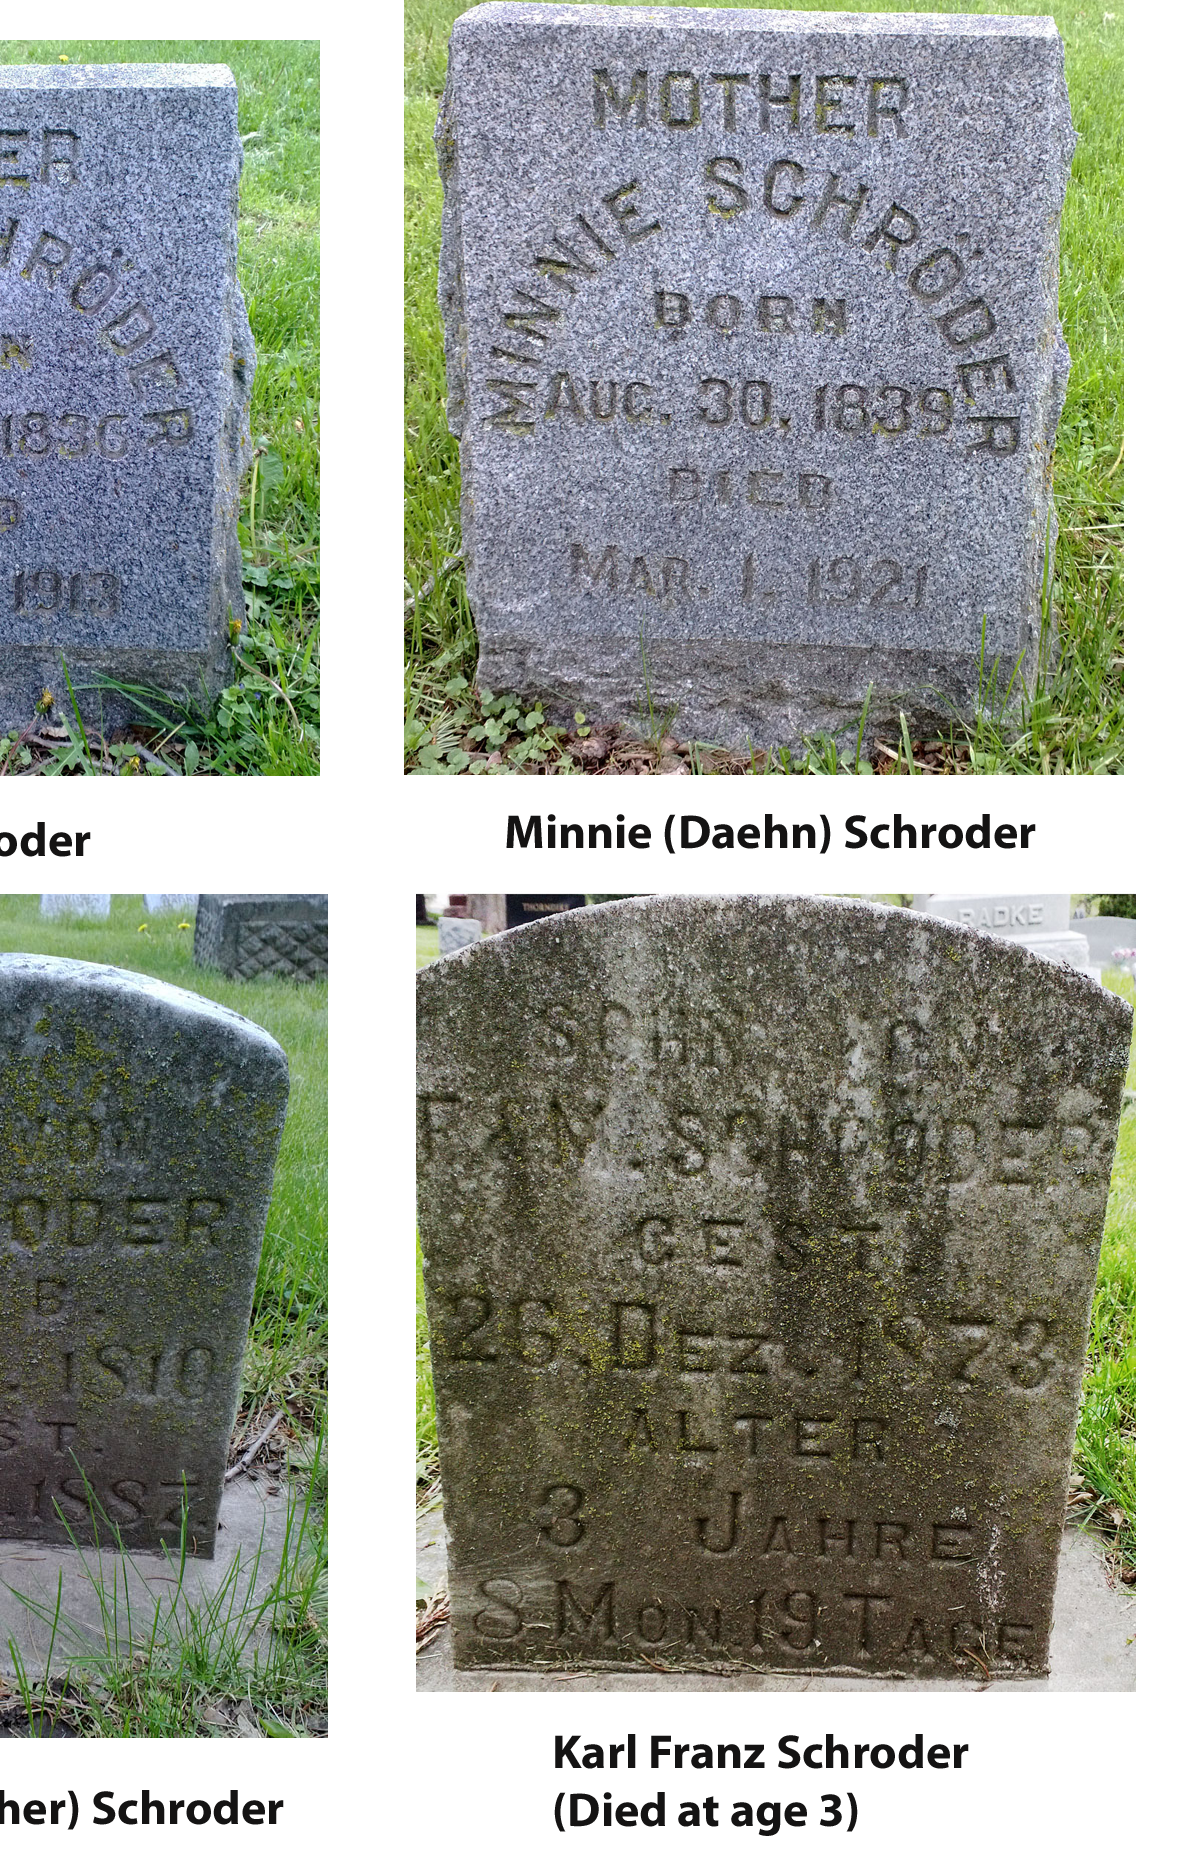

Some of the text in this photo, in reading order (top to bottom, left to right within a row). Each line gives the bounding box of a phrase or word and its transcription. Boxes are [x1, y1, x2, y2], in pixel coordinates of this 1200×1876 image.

[593, 68, 910, 138] MOTHER
[483, 156, 1022, 458] MINNIE SCHRÖDER
[654, 291, 848, 338] BORN
[700, 378, 791, 434] 30,
[813, 383, 954, 438] 1839
[668, 467, 834, 511] DIED
[807, 555, 929, 609] 1921
[958, 902, 1045, 929] RADKE
[623, 1407, 888, 1464] ALTER
[538, 1484, 590, 1548] 3
[473, 1577, 524, 1639] 8
[751, 1588, 819, 1651] 19
